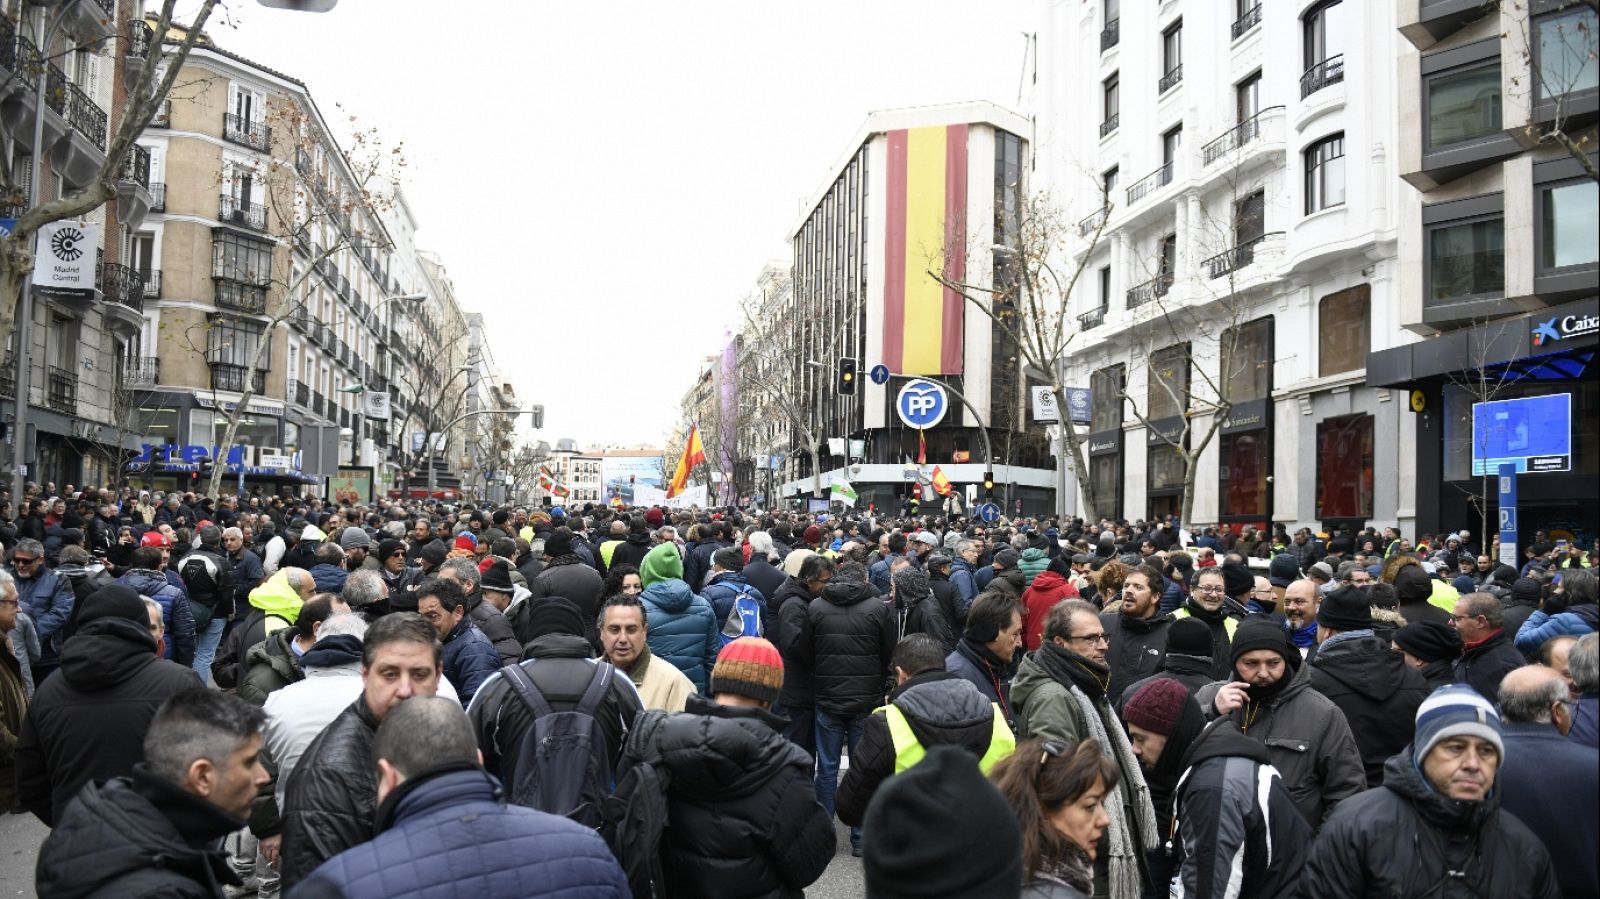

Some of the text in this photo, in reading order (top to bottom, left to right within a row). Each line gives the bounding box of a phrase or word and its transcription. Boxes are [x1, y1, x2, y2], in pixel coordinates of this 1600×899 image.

[54, 265, 80, 273] Madrid
[52, 274, 80, 282] Central
[908, 395, 936, 416] PP
[1231, 412, 1260, 427] Santander
[1096, 440, 1115, 451] Santander
[1500, 509, 1509, 529] P
